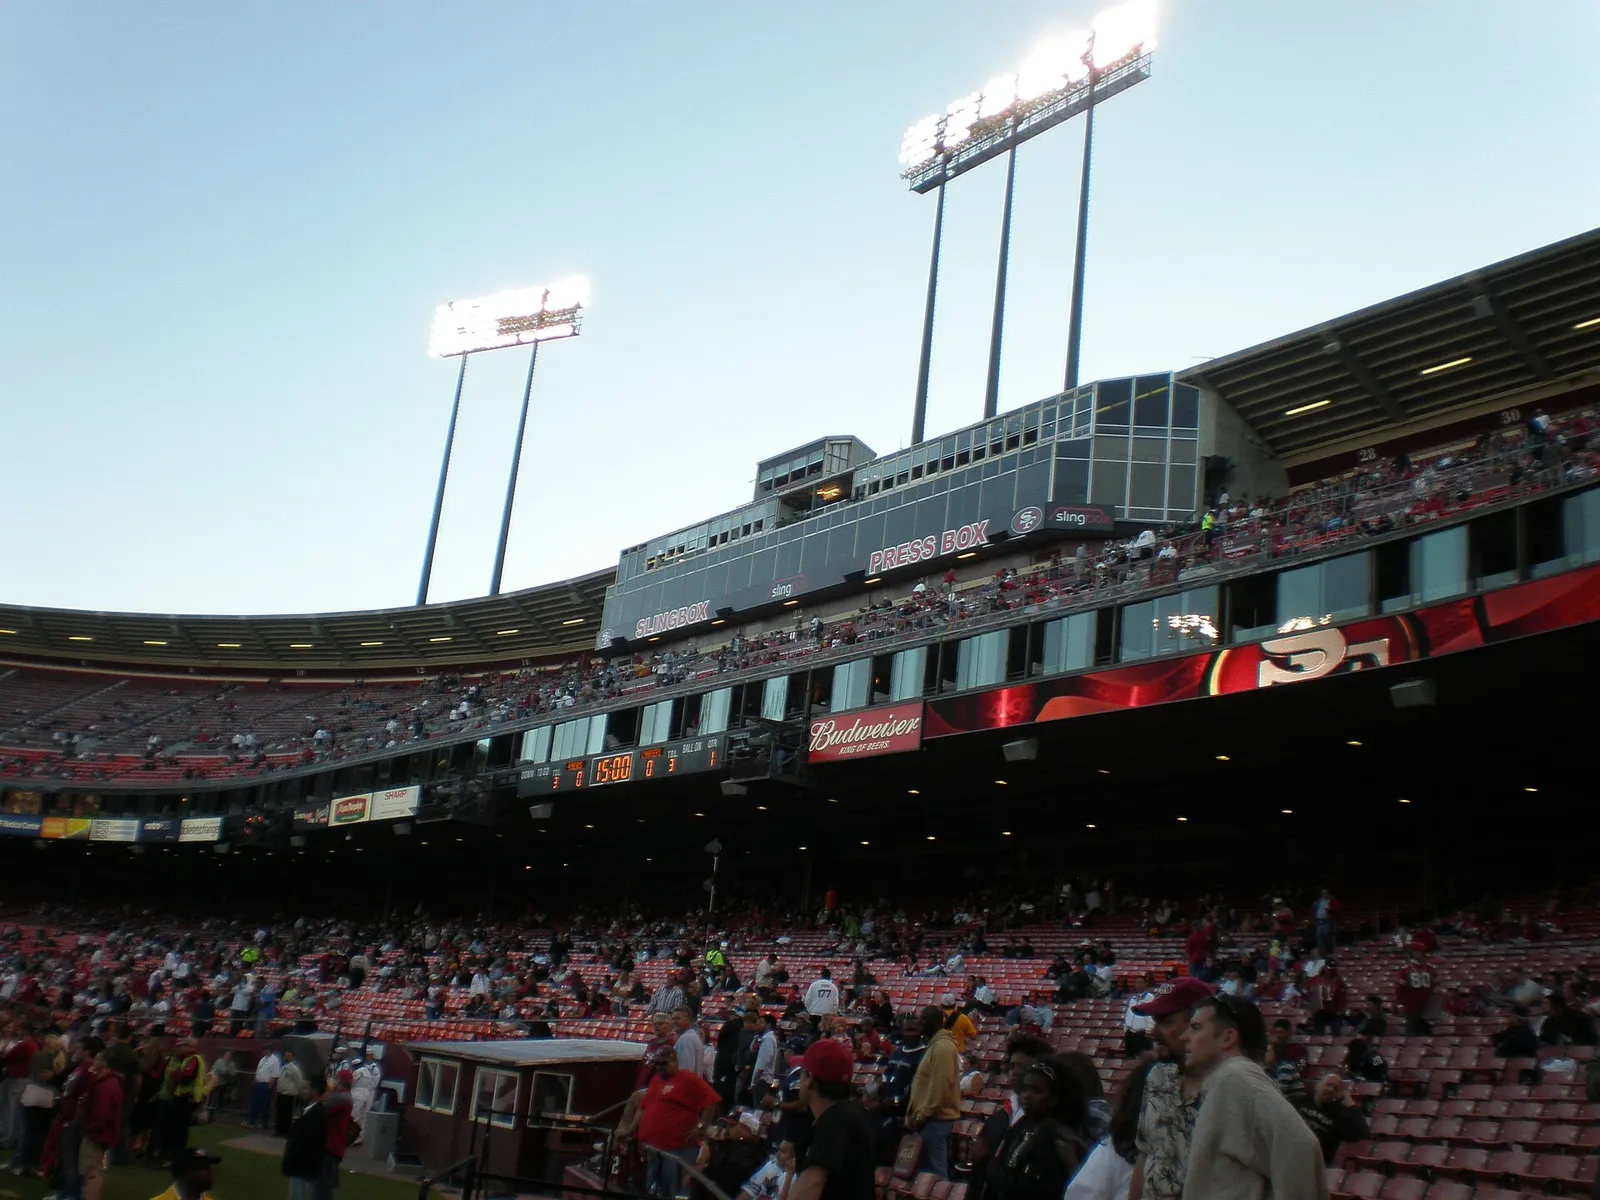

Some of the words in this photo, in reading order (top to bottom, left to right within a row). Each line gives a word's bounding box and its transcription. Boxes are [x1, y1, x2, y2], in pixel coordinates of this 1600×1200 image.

[1500, 409, 1520, 424] 30
[1359, 448, 1376, 461] 28
[868, 534, 936, 575] PRESS
[941, 519, 989, 555] BOX
[635, 600, 710, 639] SLINGBOX
[809, 714, 920, 752] Budweiser
[694, 741, 702, 752] ON
[839, 745, 856, 755] KING
[856, 744, 867, 752] OF
[668, 758, 676, 772] 3
[710, 751, 716, 766] 1
[596, 756, 631, 782] 15:00
[645, 760, 655, 777] 0
[552, 776, 560, 789] 3
[575, 771, 583, 787] 0
[385, 790, 407, 801] SHARP
